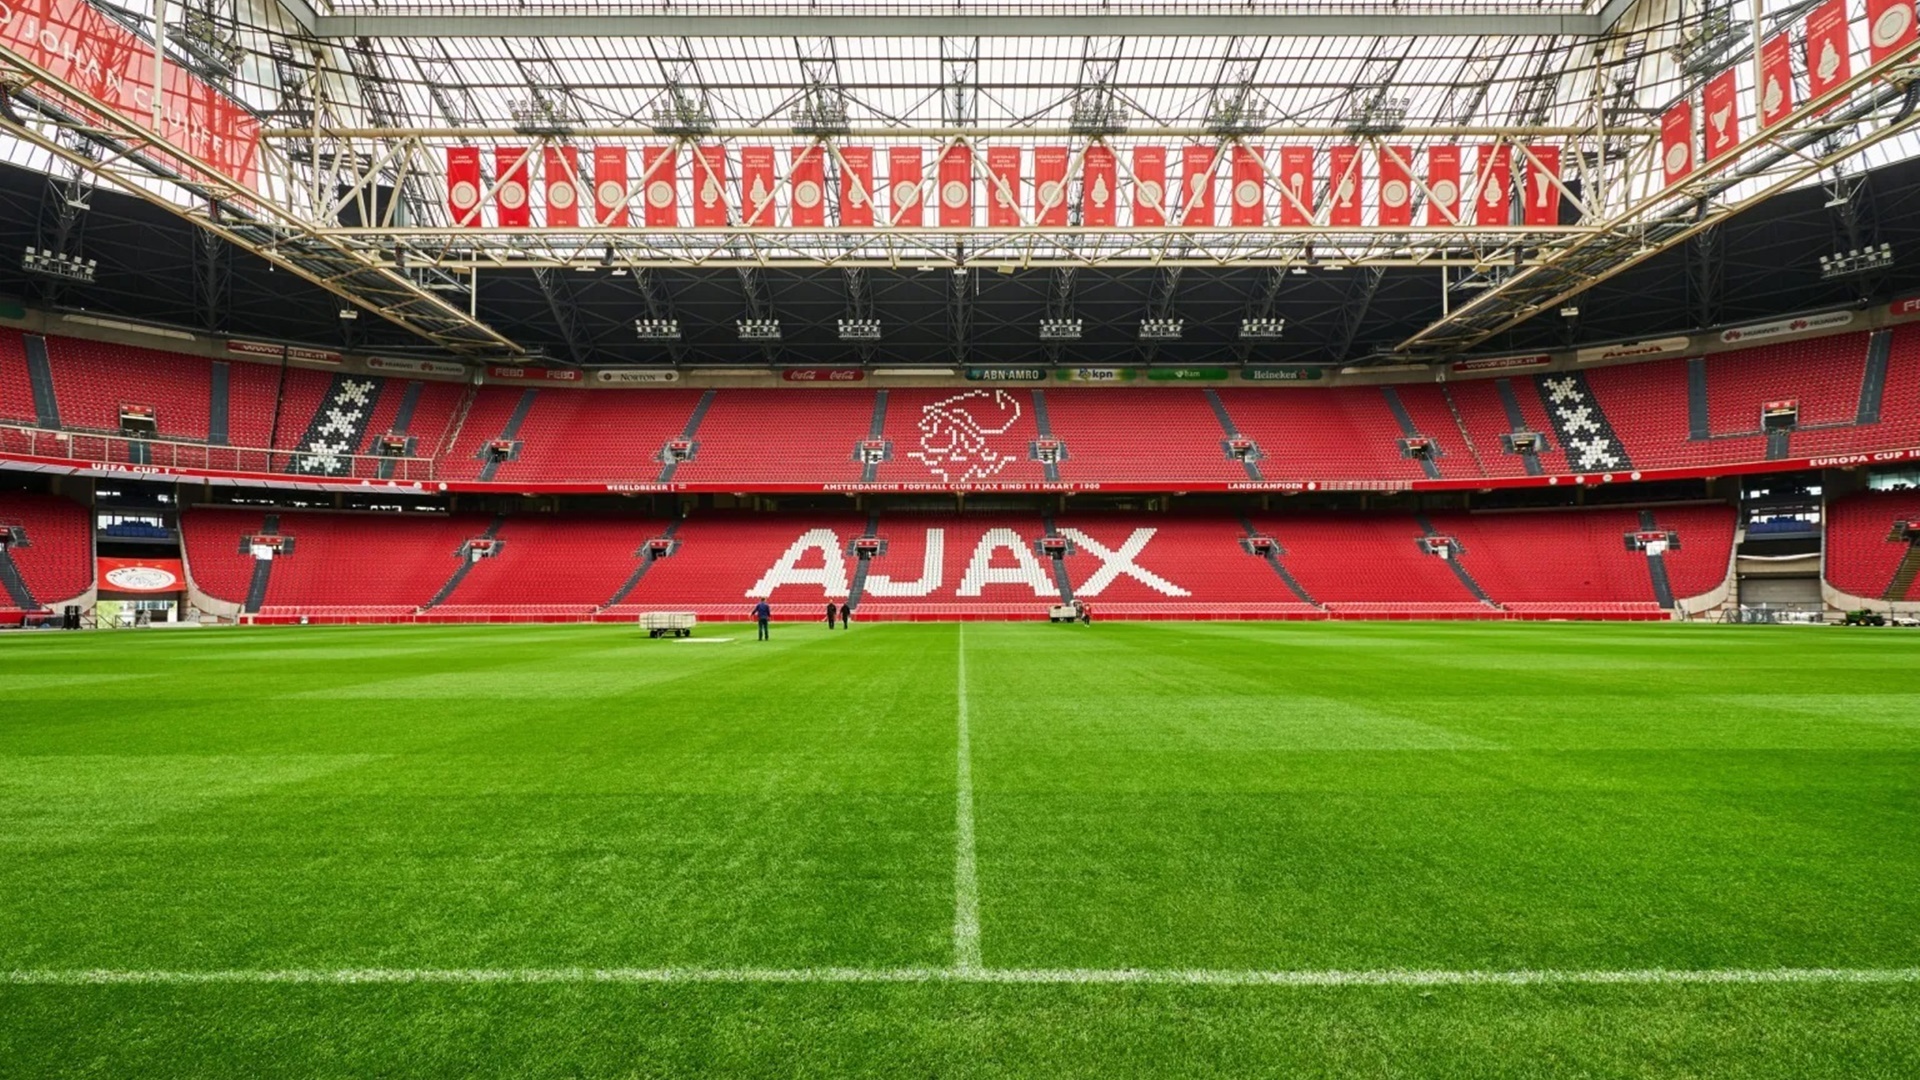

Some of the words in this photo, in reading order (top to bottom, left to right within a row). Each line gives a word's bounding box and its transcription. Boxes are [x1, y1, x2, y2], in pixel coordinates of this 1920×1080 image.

[24, 20, 123, 95] JOHAN
[134, 87, 224, 151] CUIJFF
[495, 368, 524, 377] FEBO
[546, 370, 575, 379] FEBO
[1092, 368, 1114, 380] kpn
[1253, 370, 1298, 379] Heineken
[1809, 454, 1868, 467] EUROPA
[1874, 451, 1904, 461] CUP
[91, 463, 127, 473] UEFA
[132, 465, 160, 475] CUP
[823, 483, 899, 491] AMSTERDAMSCHE
[903, 483, 947, 491] FOOTBALL
[949, 483, 972, 491] CLUB
[975, 483, 998, 491] AJAX
[1001, 483, 1026, 491] SINDS
[1043, 483, 1075, 491] MAART
[1080, 483, 1101, 491] 1900
[745, 528, 1192, 597] AJAX
